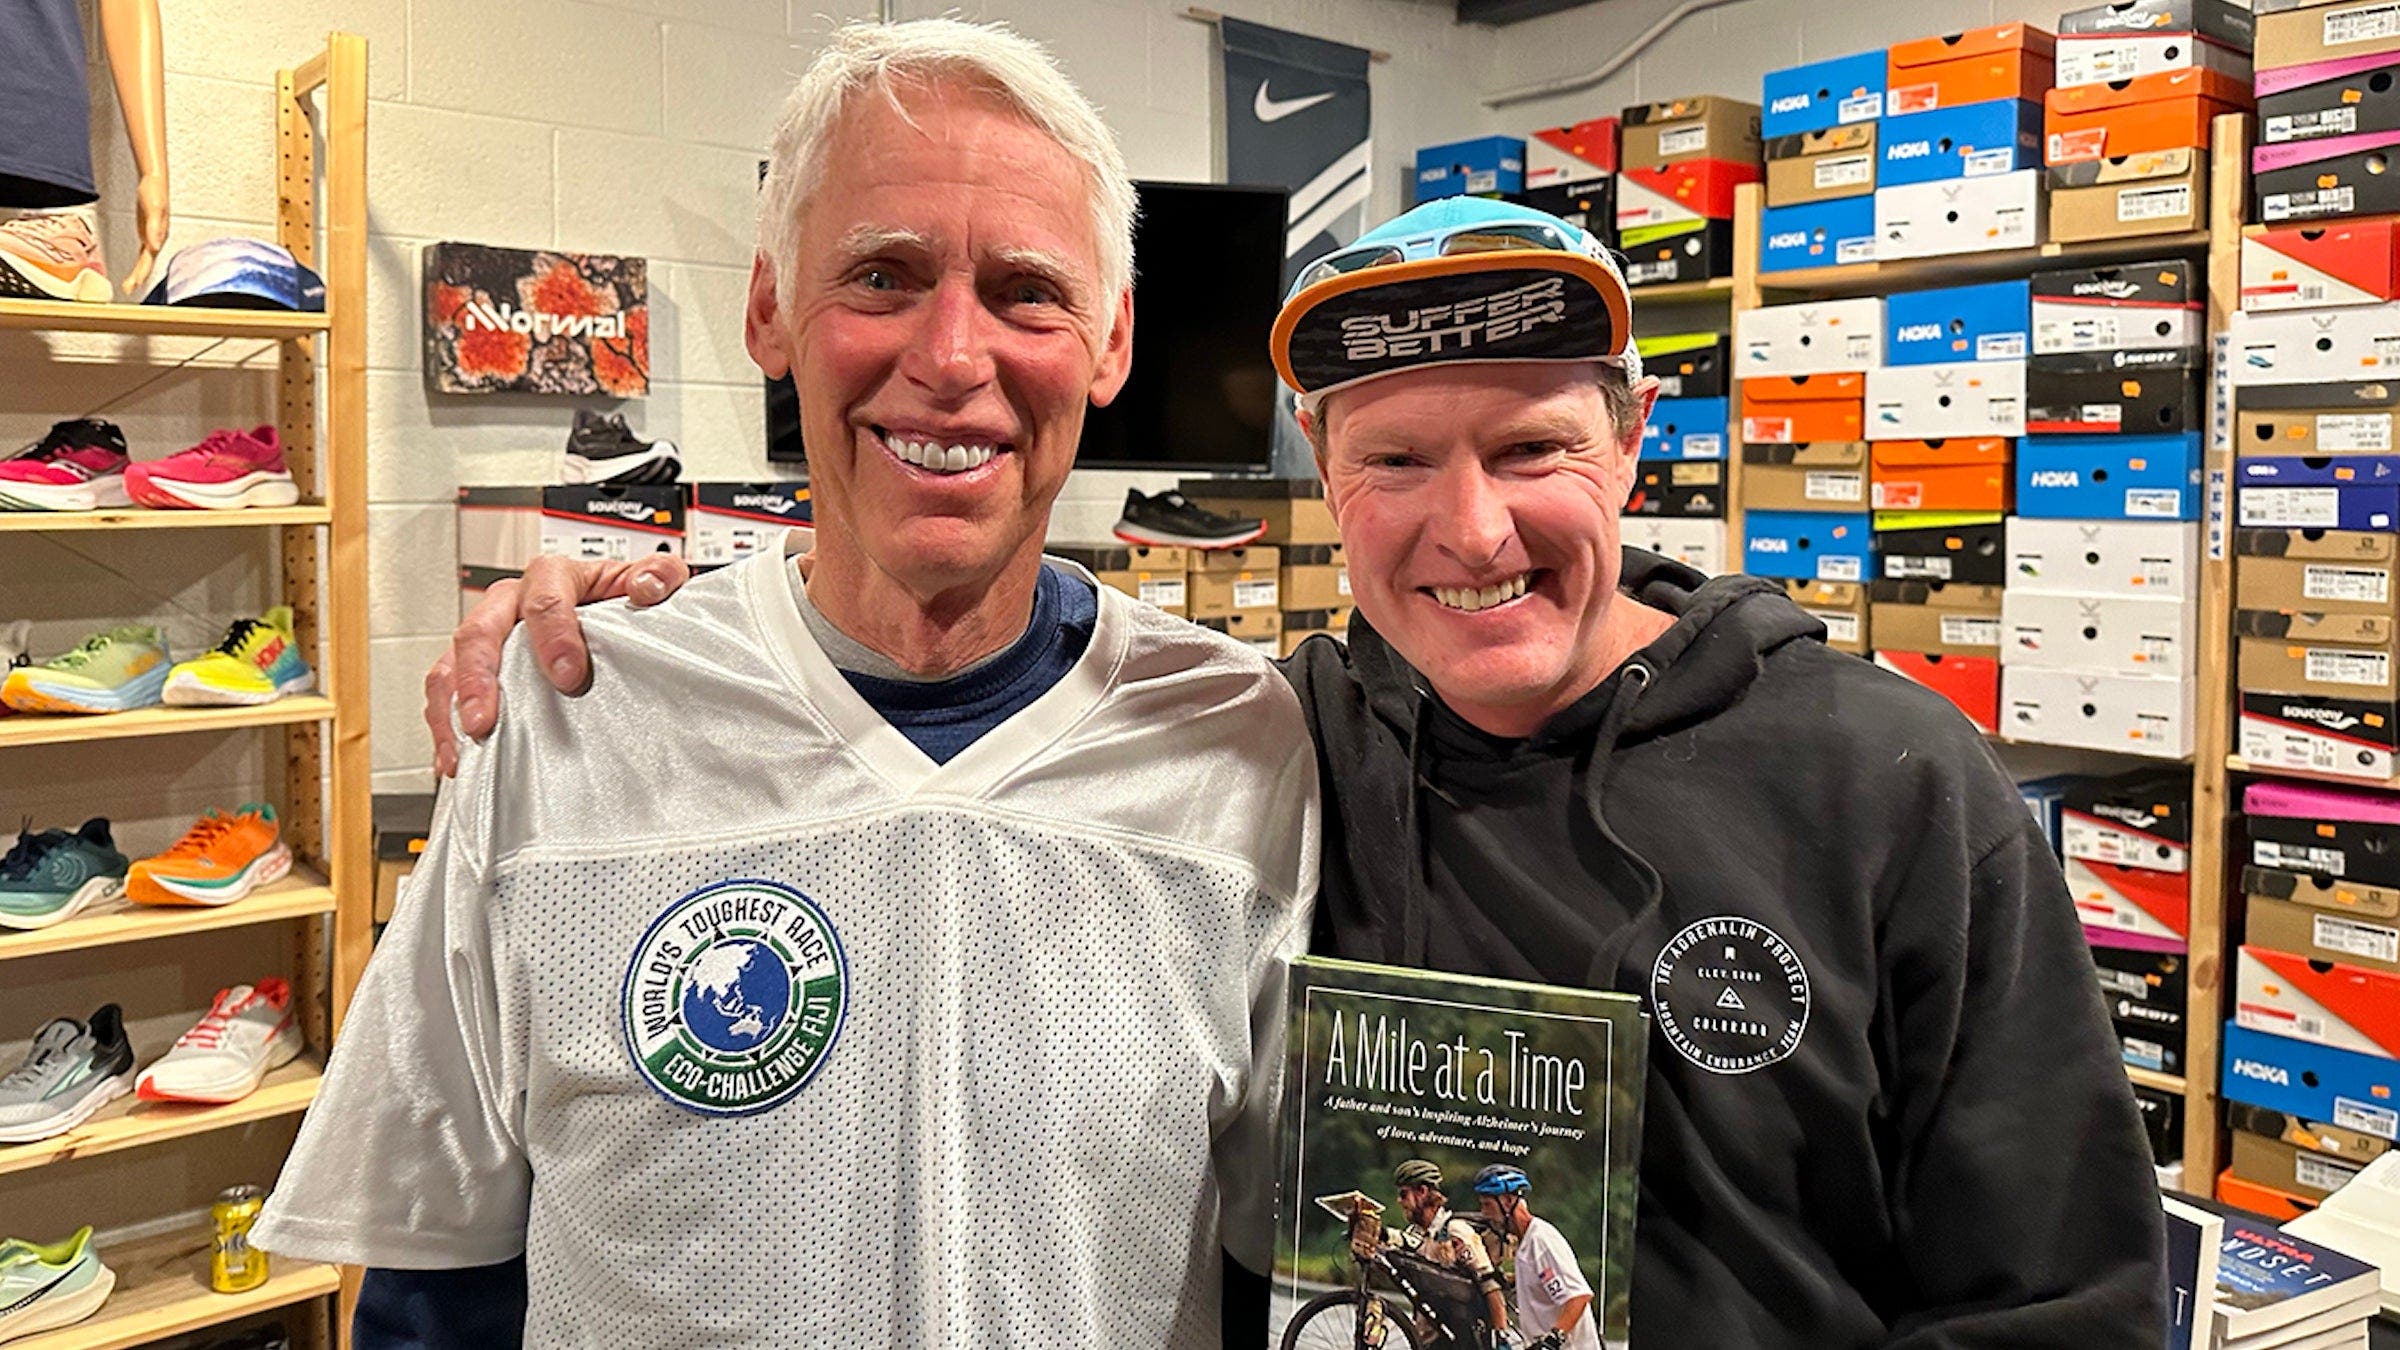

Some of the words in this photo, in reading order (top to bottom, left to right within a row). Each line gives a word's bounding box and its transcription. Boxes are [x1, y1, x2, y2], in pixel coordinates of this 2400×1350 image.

[1771, 94, 1810, 114] HOKA
[1888, 141, 1930, 160] HOKA
[1769, 232, 1807, 250] HOKA
[1341, 277, 1565, 339] SUFFER
[1342, 300, 1566, 360] BETTER
[1898, 324, 1942, 342] HOKA
[2031, 471, 2079, 487] HOKA
[588, 501, 645, 516] saucony
[1750, 537, 1788, 553] HOKA
[2282, 706, 2349, 725] saucony
[643, 940, 682, 1041] WORLD'S
[680, 898, 787, 940] TOUGHEST
[785, 916, 829, 969] RACE
[1657, 960, 1675, 985] THE
[1670, 921, 1758, 959] ADRENALIN
[1762, 936, 1806, 1005] PROJECT
[1658, 1001, 1703, 1059] MOUNTAIN
[1705, 1048, 1778, 1069] ENDURANCE
[1780, 1019, 1800, 1049] TEAM
[1693, 1016, 1768, 1037] COLORADO
[663, 1037, 814, 1100] ECO-CHALLENGE
[802, 996, 832, 1038] FIJI
[1325, 1009, 1347, 1087] A
[1355, 1013, 1427, 1097] Mile
[1434, 1034, 1470, 1102] at
[1476, 1048, 1496, 1106] a
[1504, 1030, 1585, 1116] Time
[2233, 1058, 2289, 1087] HOKA
[1324, 1096, 1334, 1107] A
[1333, 1096, 1368, 1111] father
[1368, 1103, 1391, 1114] and
[1393, 1106, 1420, 1118] son's
[1422, 1107, 1472, 1127] inspiring
[1472, 1115, 1538, 1133] Alzheimer's
[1538, 1122, 1586, 1140] journey
[1377, 1126, 1391, 1139] of
[1391, 1126, 1416, 1141] love,
[1418, 1131, 1475, 1149] adventure,
[1478, 1140, 1500, 1151] and
[1502, 1140, 1531, 1156] hope
